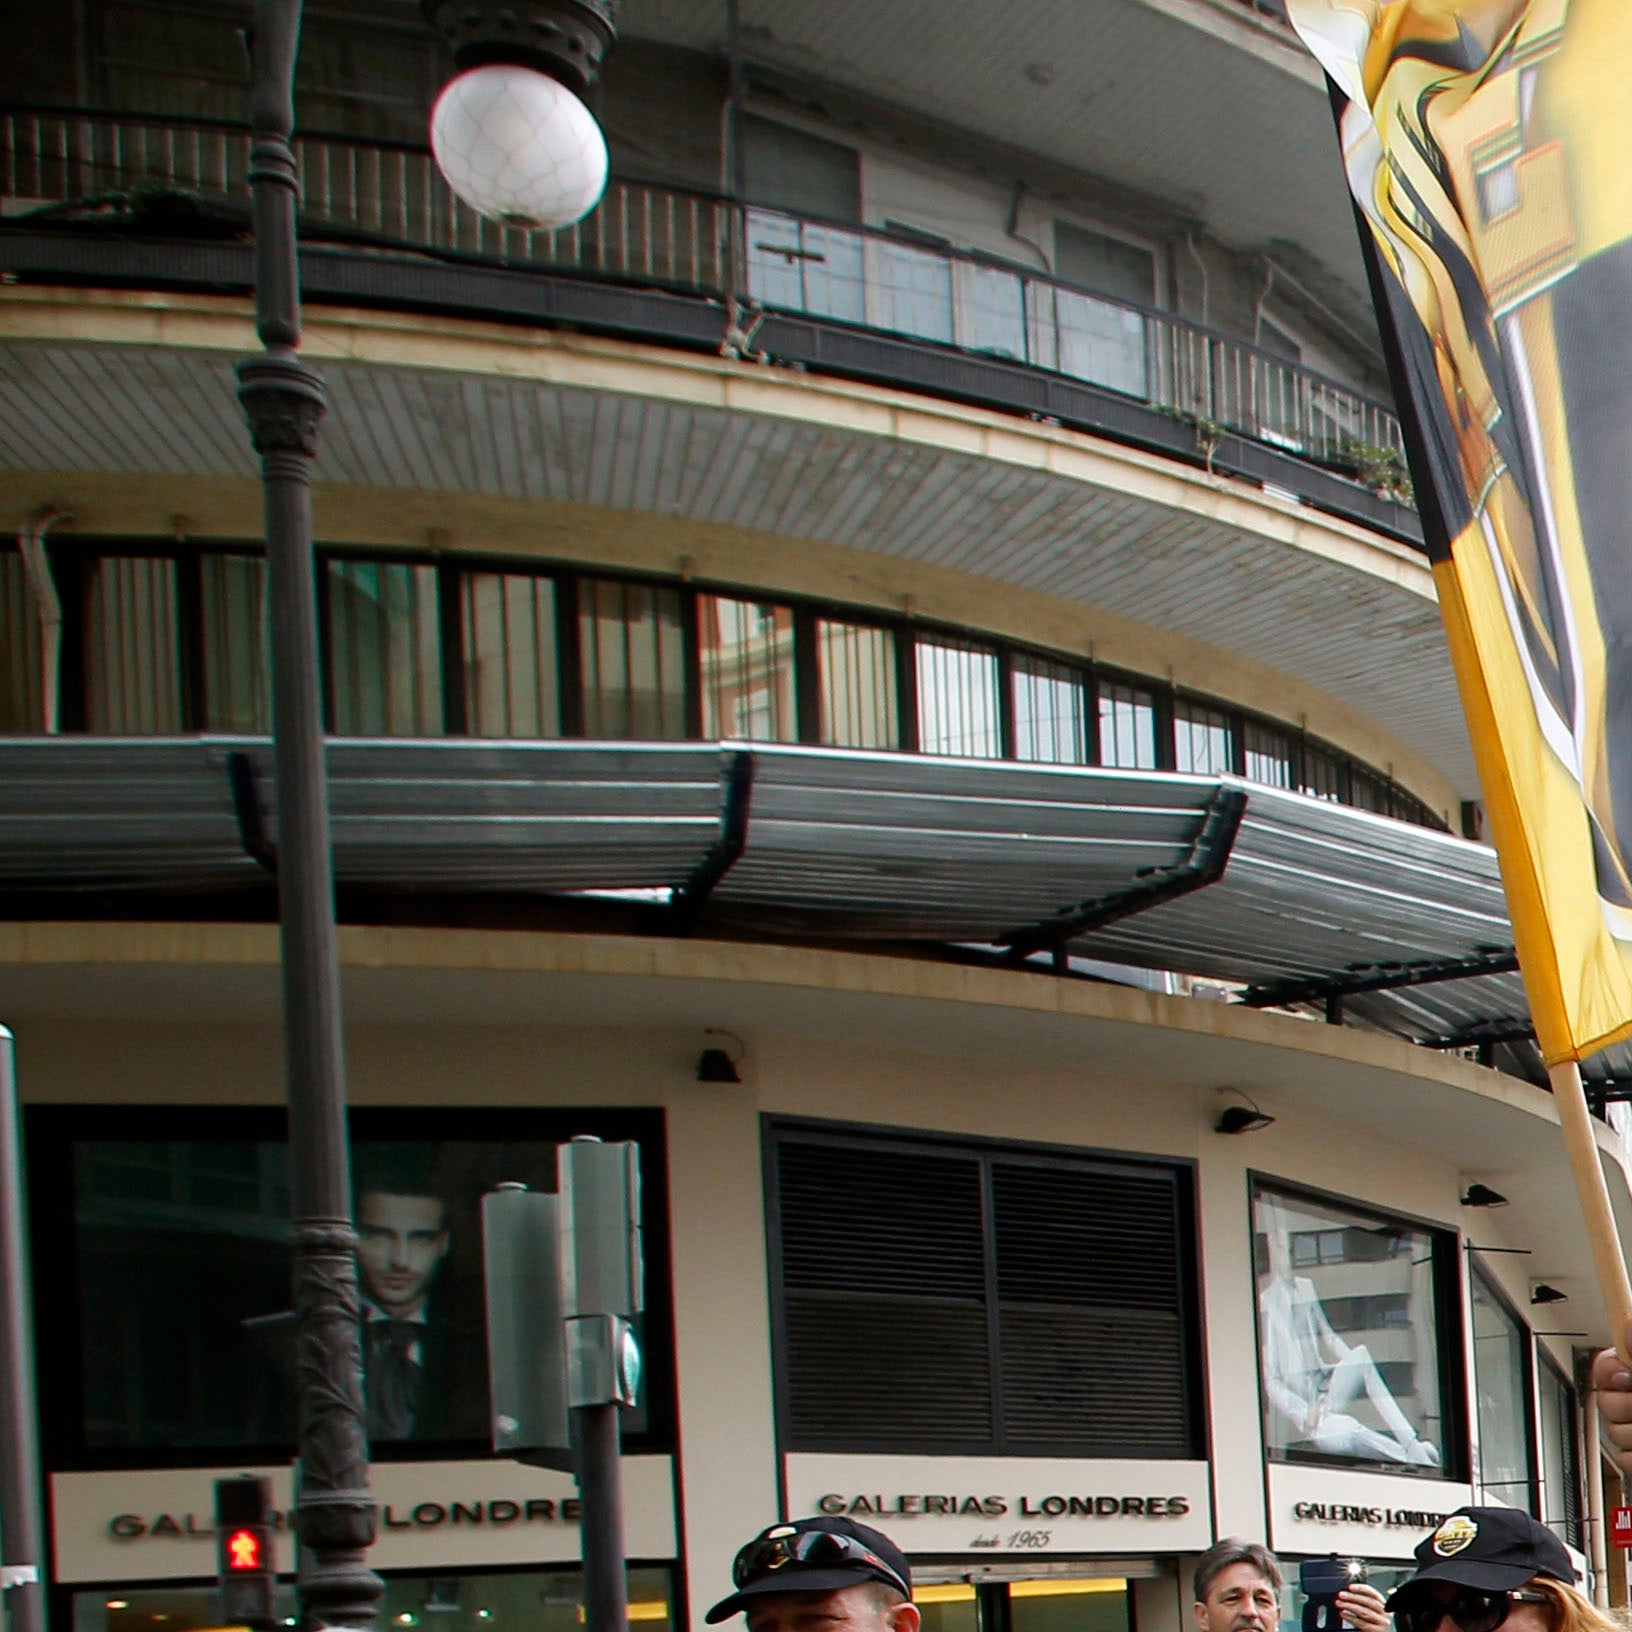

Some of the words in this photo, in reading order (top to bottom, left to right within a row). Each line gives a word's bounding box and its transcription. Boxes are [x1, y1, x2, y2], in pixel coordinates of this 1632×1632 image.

[383, 1499, 581, 1529] LONDRE
[818, 1493, 1009, 1516] GALERIAS
[1020, 1496, 1190, 1517] LONDRES
[1294, 1502, 1382, 1524] GALERIAS
[1386, 1508, 1449, 1529] LONDR
[1007, 1529, 1053, 1549] 1965
